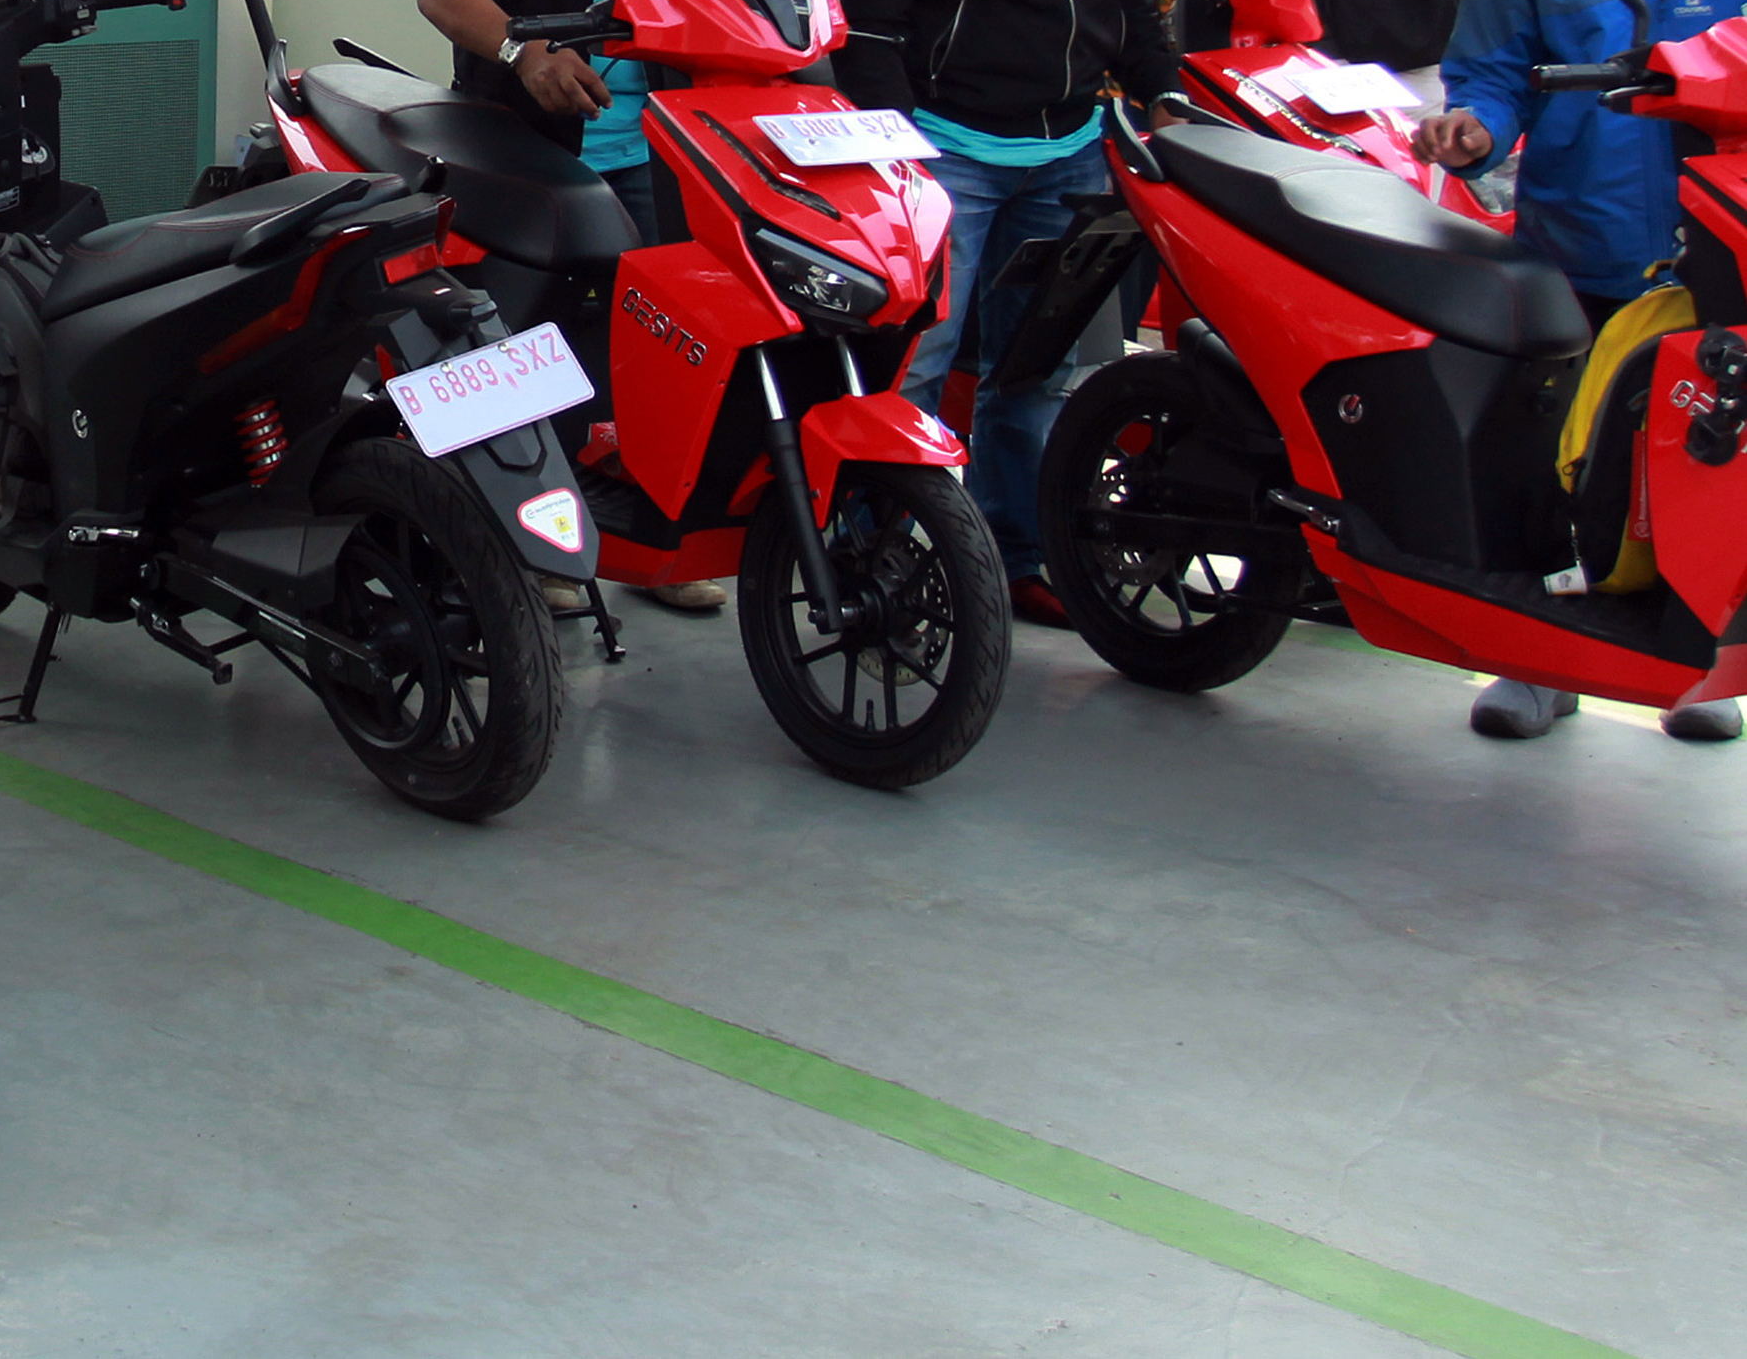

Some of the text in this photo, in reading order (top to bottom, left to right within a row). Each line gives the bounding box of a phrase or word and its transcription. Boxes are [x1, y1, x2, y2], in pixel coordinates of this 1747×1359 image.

[622, 287, 708, 366] GESITS
[398, 332, 566, 415] B 6889 SXZ
